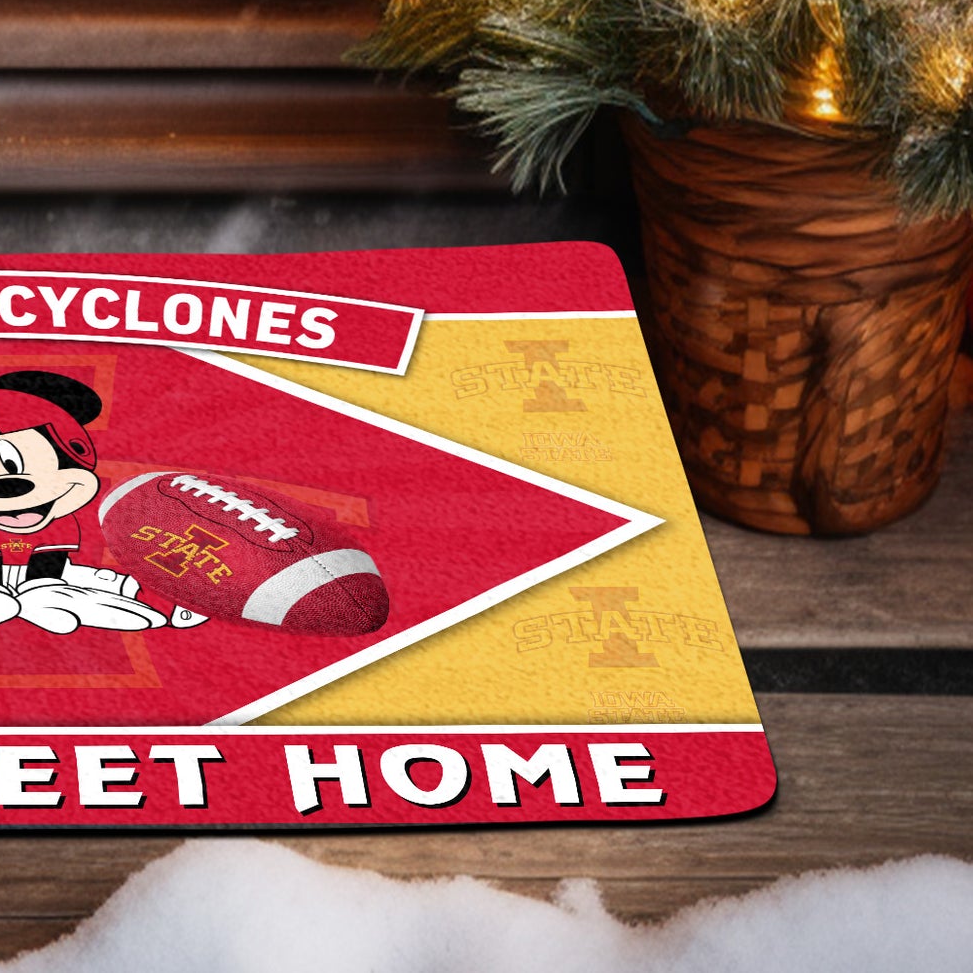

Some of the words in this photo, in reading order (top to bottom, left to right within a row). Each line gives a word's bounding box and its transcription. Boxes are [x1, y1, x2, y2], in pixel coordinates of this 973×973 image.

[450, 360, 647, 400] STATE
[522, 432, 601, 448] IOWA
[520, 447, 612, 462] STATE
[0, 542, 33, 550] STATE
[130, 525, 233, 585] STATE
[512, 610, 725, 653] STATE
[591, 691, 676, 708] IOWA
[284, 741, 667, 814] HOME
